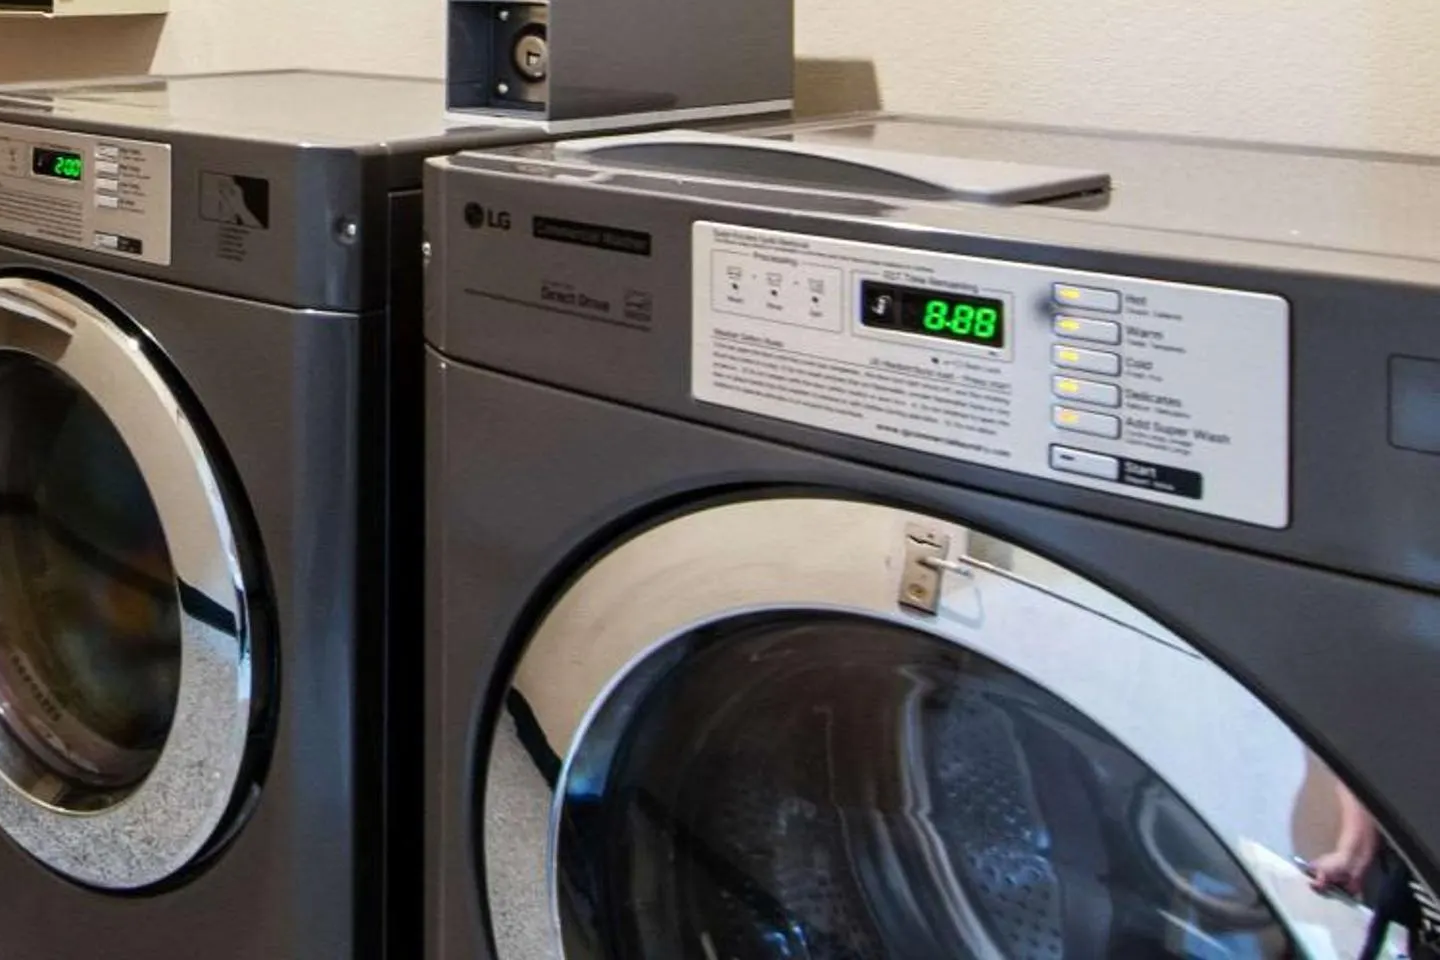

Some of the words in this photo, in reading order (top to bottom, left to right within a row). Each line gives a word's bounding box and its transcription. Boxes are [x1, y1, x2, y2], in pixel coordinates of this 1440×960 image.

[487, 209, 511, 230] LG
[1125, 326, 1164, 341] Warm
[1125, 357, 1154, 371] Cold
[1125, 417, 1151, 431] Add
[1153, 422, 1189, 438] Super
[1193, 429, 1231, 445] Wash
[1124, 461, 1158, 479] Start
